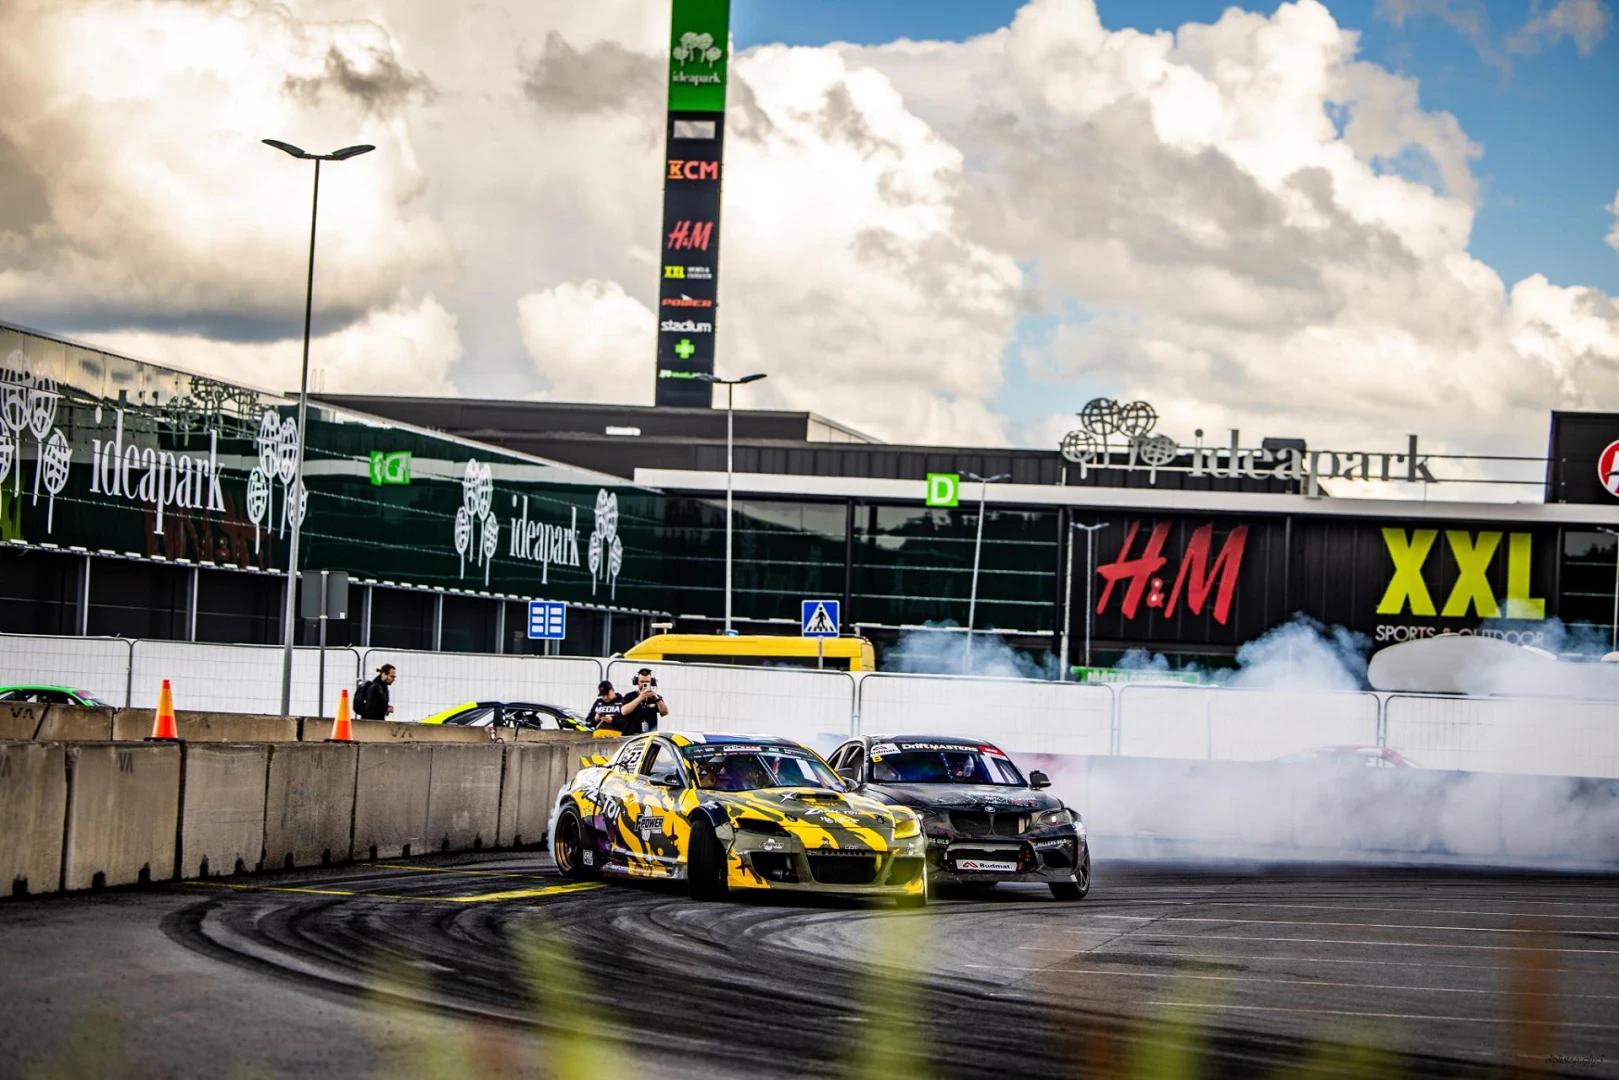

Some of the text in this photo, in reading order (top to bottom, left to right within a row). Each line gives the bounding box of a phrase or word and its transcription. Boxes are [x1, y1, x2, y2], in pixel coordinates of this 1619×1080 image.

[672, 71, 721, 86] ideapark
[667, 220, 714, 252] H&M
[664, 266, 686, 279] XXL
[661, 298, 713, 308] POWER
[661, 319, 712, 333] stadium
[90, 407, 226, 535] ideapark
[1187, 428, 1439, 500] ideapark
[930, 476, 955, 504] D
[509, 494, 581, 585] ideapark
[1096, 519, 1249, 626] H&M
[1376, 527, 1546, 620] XXL
[1374, 625, 1436, 642] SPORTS
[594, 705, 621, 714] MEDIA
